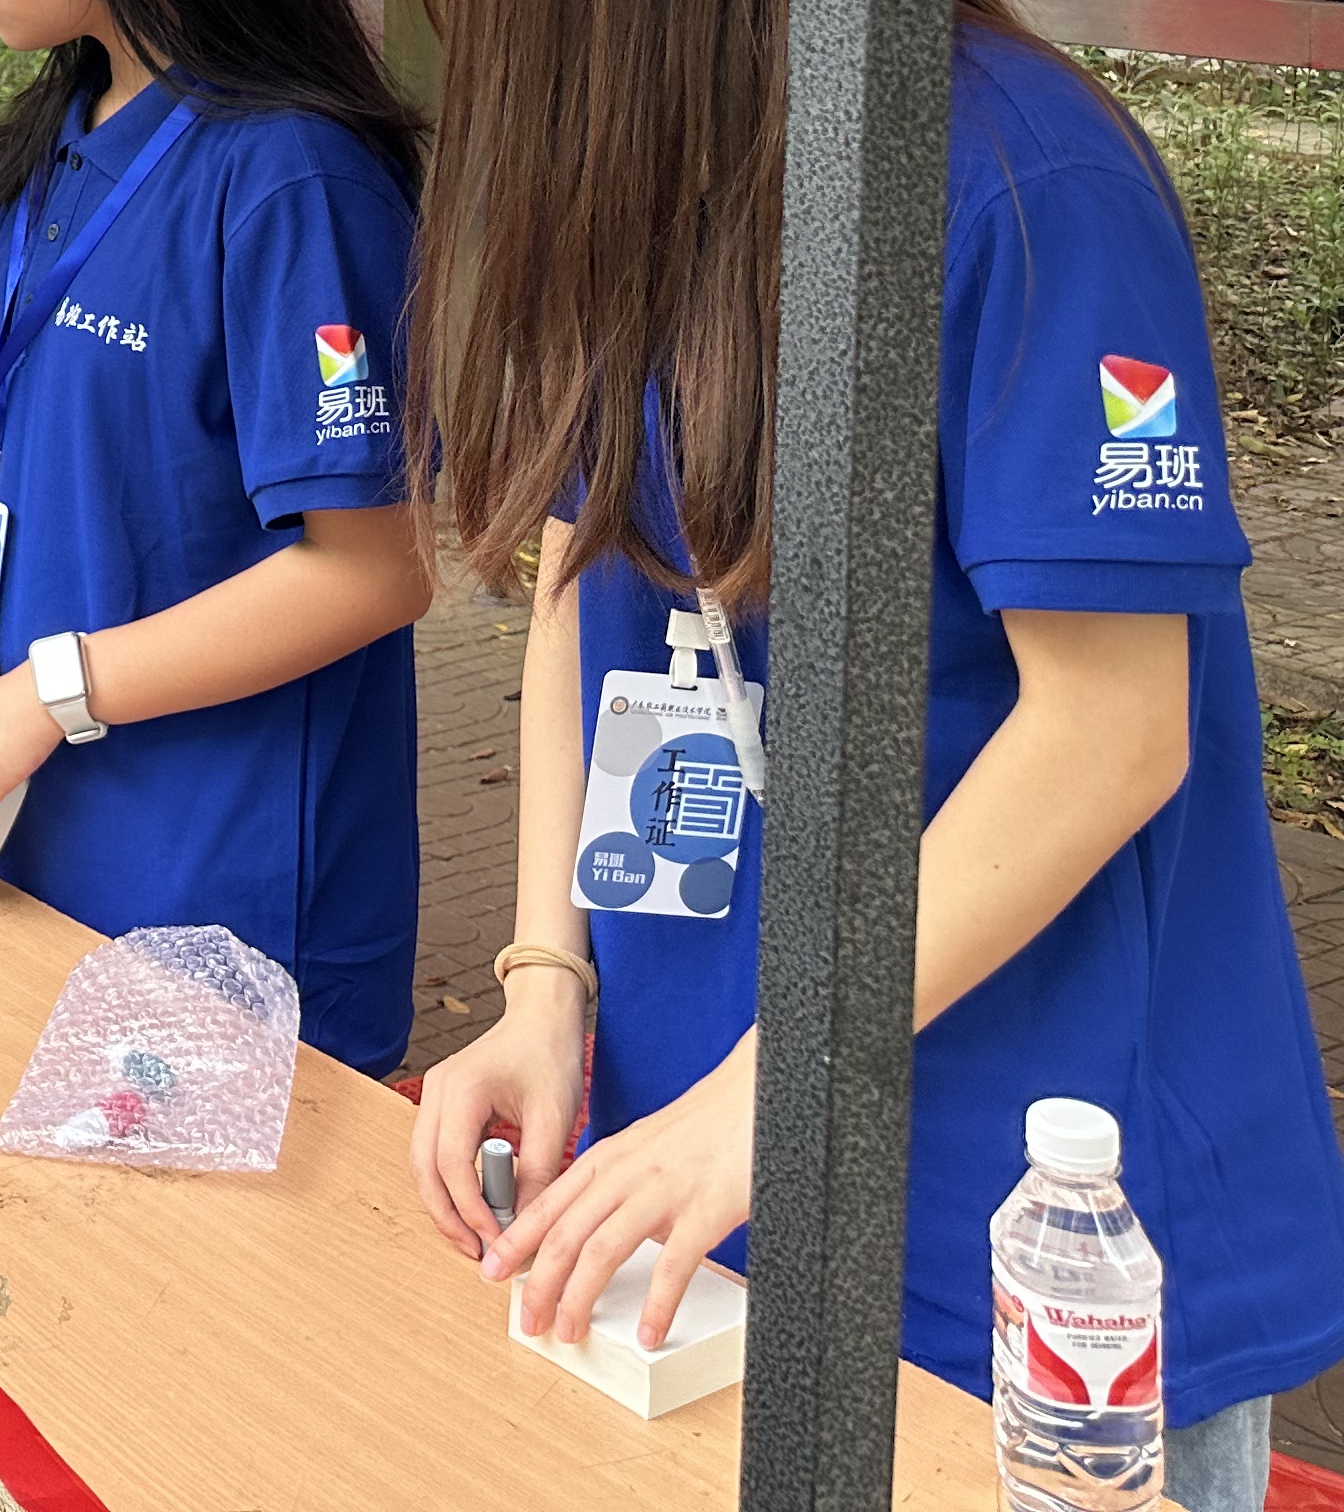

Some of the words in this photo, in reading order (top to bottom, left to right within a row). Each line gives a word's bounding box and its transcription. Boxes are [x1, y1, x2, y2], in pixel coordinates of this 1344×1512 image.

[315, 385, 390, 426] 易班
[315, 420, 391, 446] yiban.cn
[1093, 442, 1204, 489] 易班
[1091, 489, 1203, 516] yiban.cn
[644, 748, 687, 848] 工作证
[592, 867, 609, 882] Yi
[611, 869, 646, 885] Ban
[1044, 1304, 1148, 1332] Wahaha
